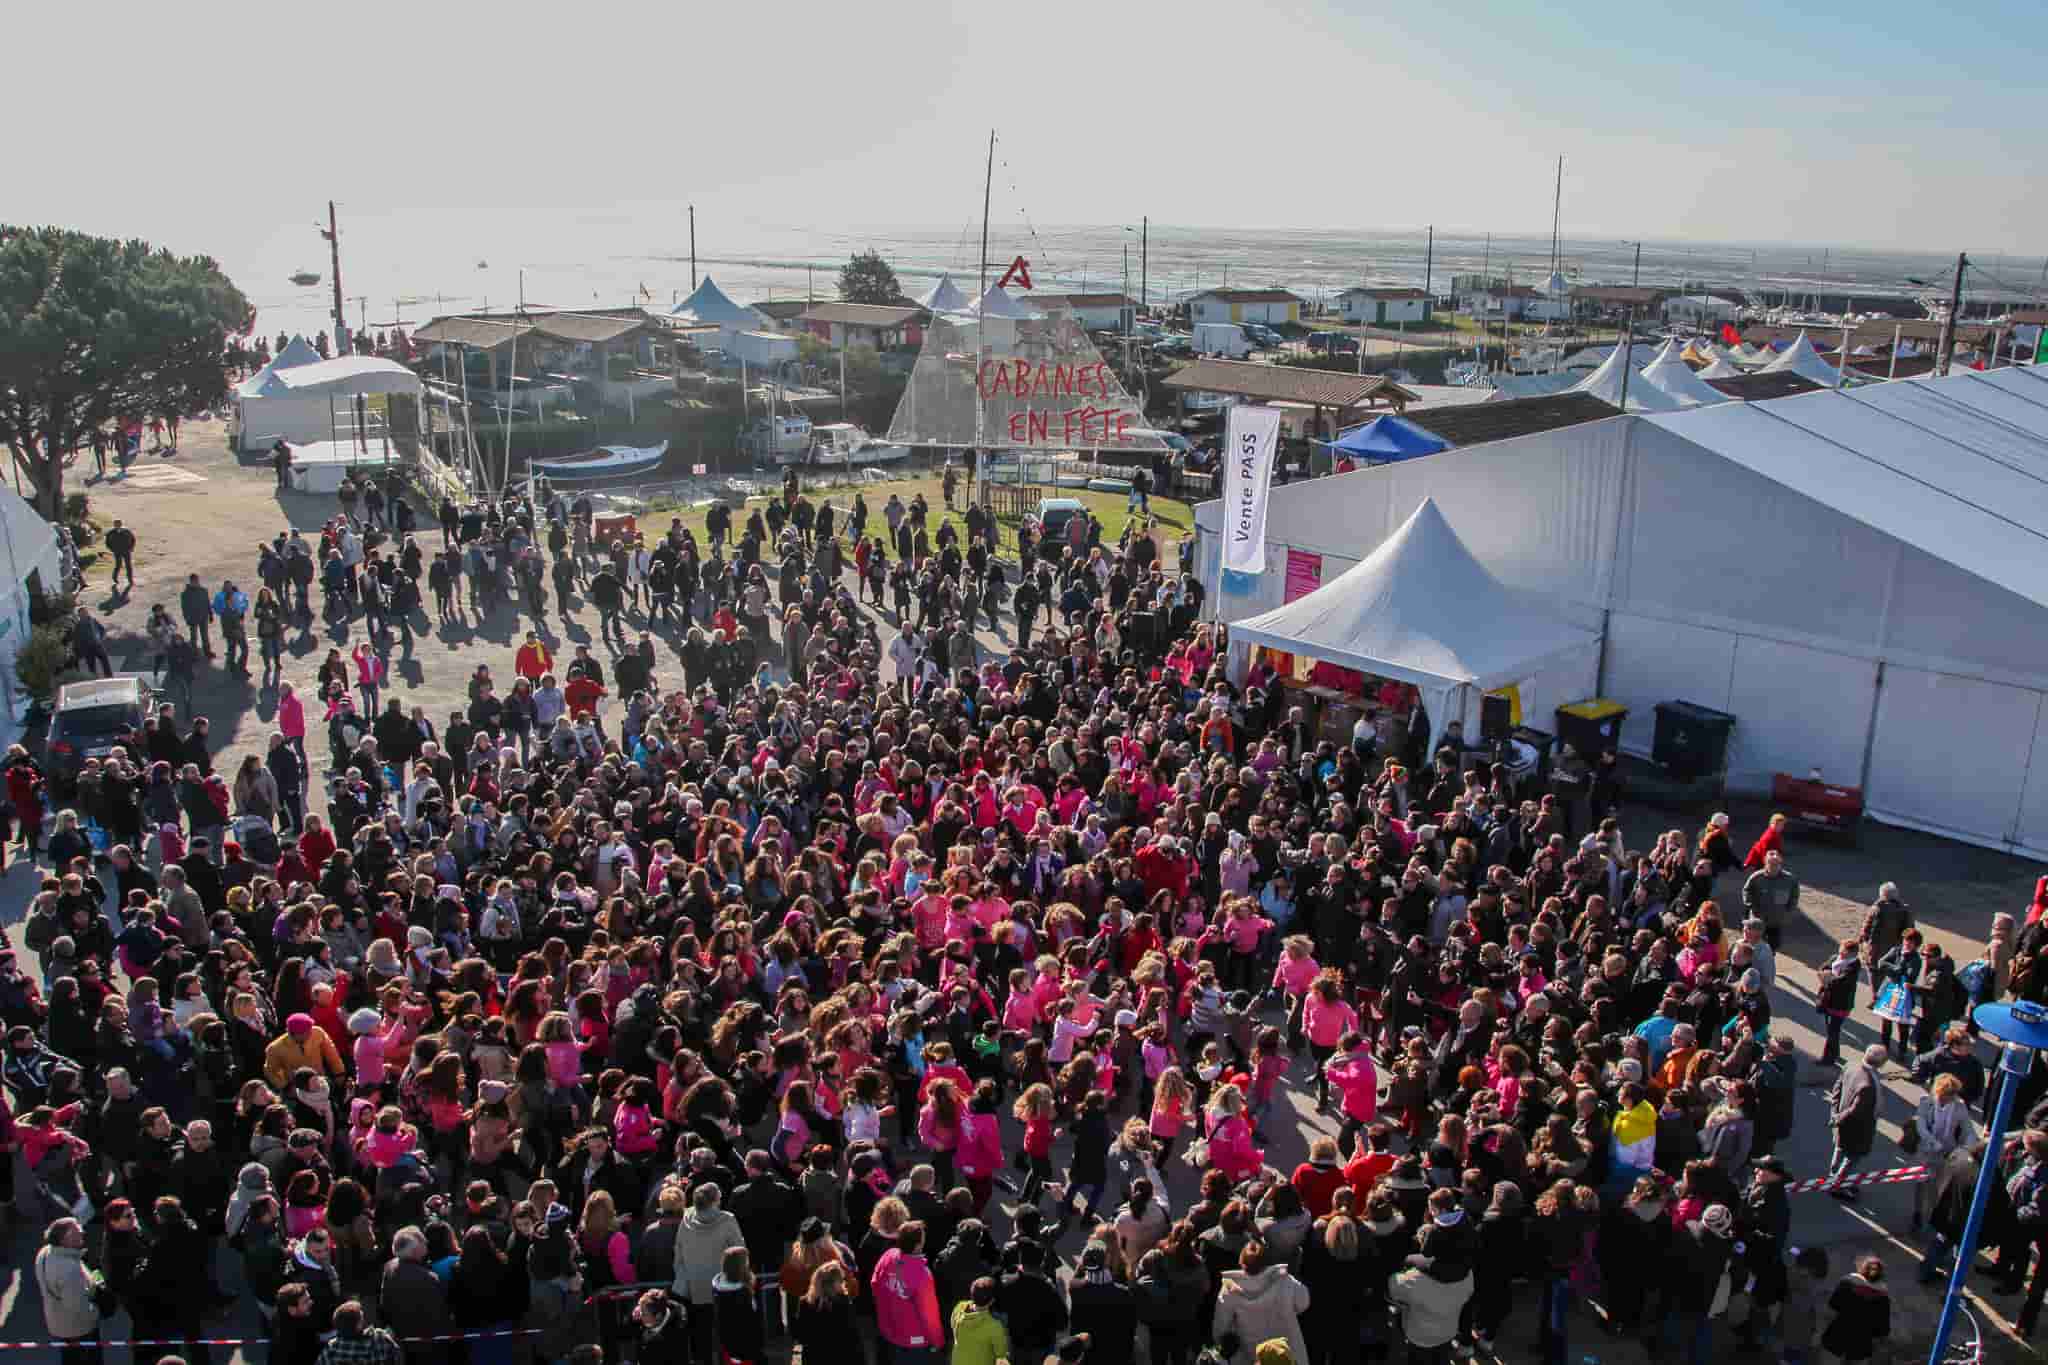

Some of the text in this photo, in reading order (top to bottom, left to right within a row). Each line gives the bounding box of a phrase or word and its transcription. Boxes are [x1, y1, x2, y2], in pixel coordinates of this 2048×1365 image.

[978, 360, 1108, 400] CABANES
[1009, 406, 1136, 445] EN FÊTE
[1234, 432, 1257, 543] Vente PASS
